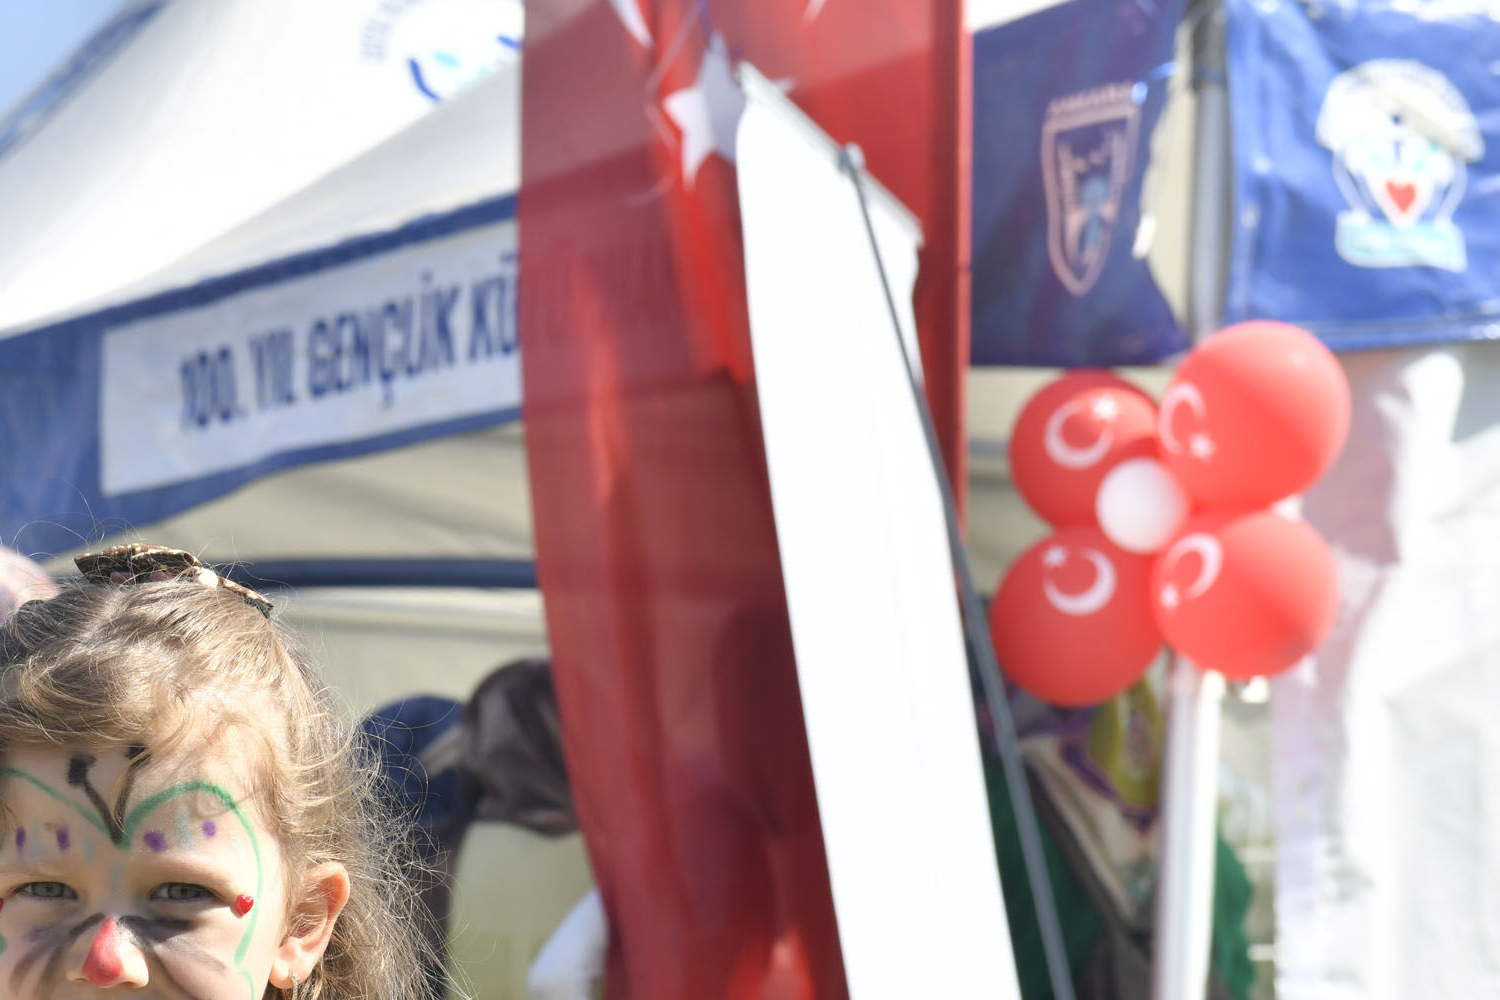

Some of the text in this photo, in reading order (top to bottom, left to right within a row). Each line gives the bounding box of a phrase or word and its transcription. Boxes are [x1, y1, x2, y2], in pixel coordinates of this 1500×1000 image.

[180, 346, 248, 432] 100.
[247, 322, 296, 410] YIL
[306, 270, 462, 410] GENÇLİK
